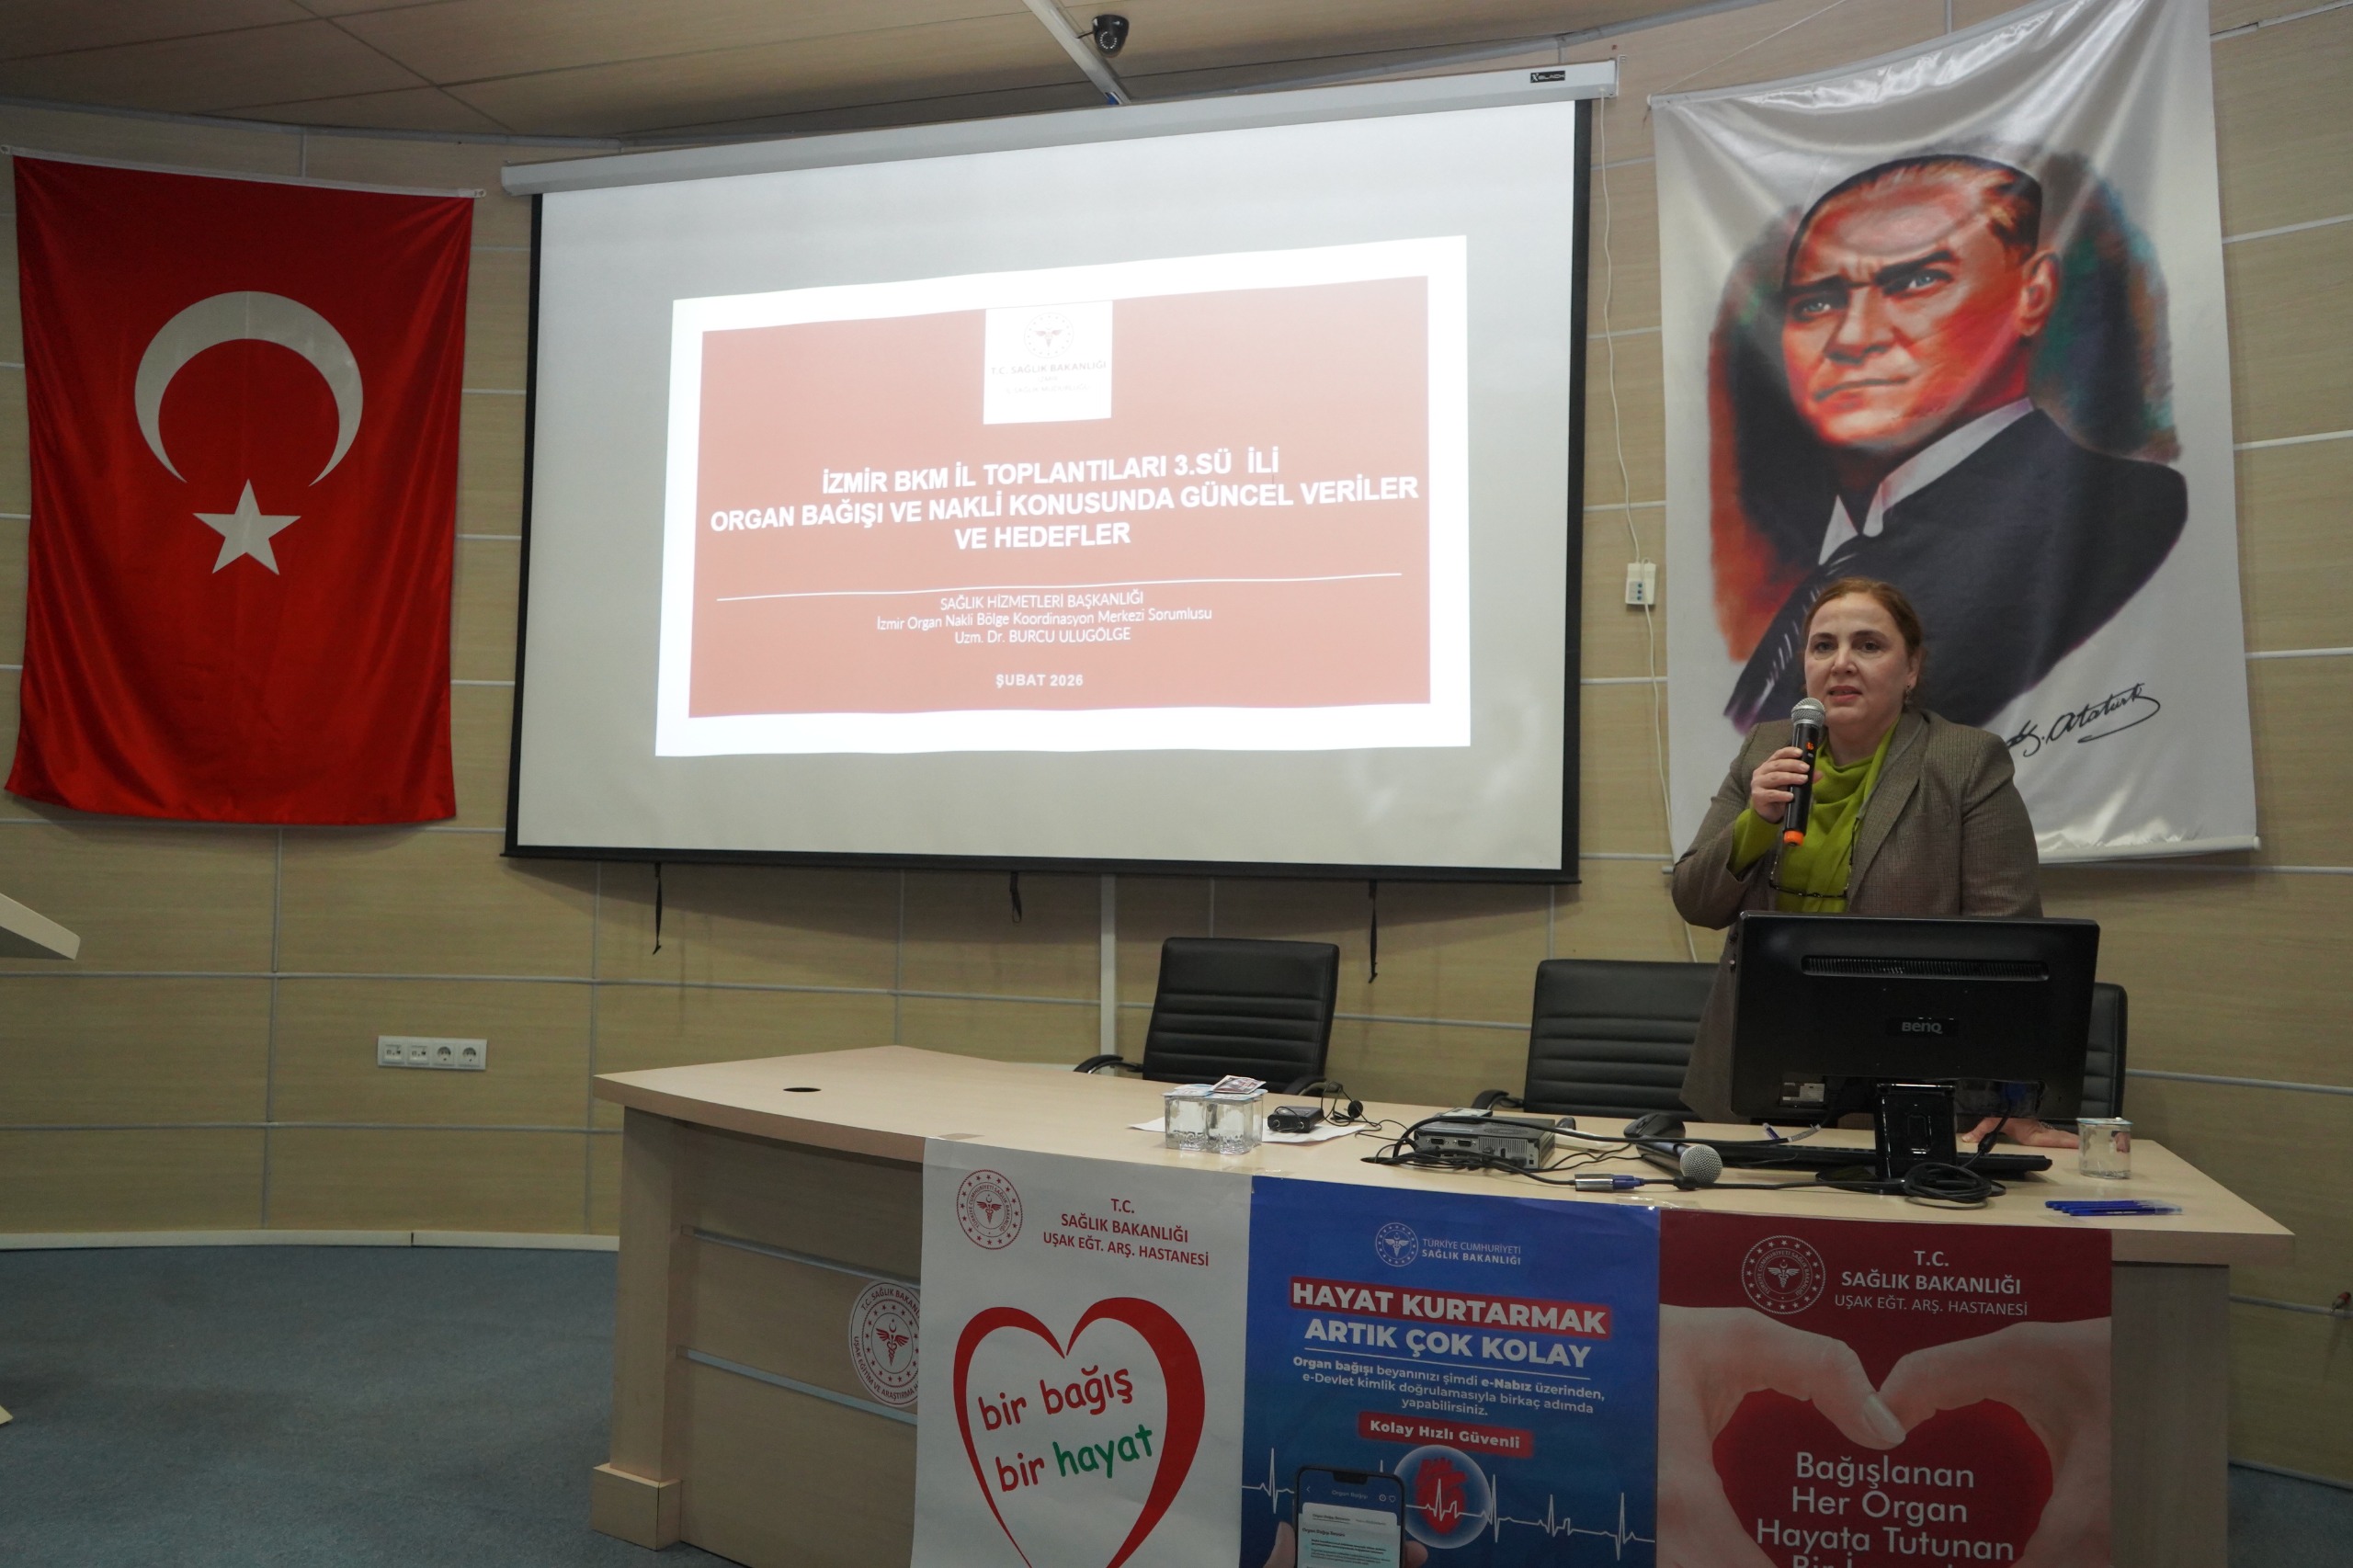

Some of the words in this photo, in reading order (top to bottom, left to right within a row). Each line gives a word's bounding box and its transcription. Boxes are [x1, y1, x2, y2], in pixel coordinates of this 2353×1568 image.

[1011, 364, 1047, 374] SAĞLIK
[1051, 360, 1107, 372] BAKANLIĞI
[823, 467, 888, 494] İZMİR
[894, 467, 949, 492] BKM
[955, 461, 976, 487] İL
[983, 455, 1166, 485] TOPLANTILARI
[1174, 448, 1232, 475] 3.SÜ
[1247, 446, 1279, 473] İLİ
[710, 506, 794, 531] ORGAN
[801, 498, 883, 528] BAĞIŞI
[890, 501, 922, 523] VE
[929, 491, 1002, 520] NAKLİ
[1009, 487, 1175, 516] KONUSUNDA
[1180, 481, 1293, 507] GÜNCEL
[1300, 473, 1419, 505] VERİLER
[954, 528, 987, 550] VE
[995, 522, 1131, 548] HEDEFLER
[940, 595, 983, 610] SAĞLIK
[987, 594, 1063, 608] HİZMETLERİ
[1067, 588, 1143, 609] BAŞKANLIĞI
[877, 616, 904, 631] İzmir
[907, 617, 942, 631] Organ
[945, 613, 973, 627] Nakli
[977, 612, 1009, 628] Bölge
[1013, 611, 1094, 627] Koordinasyon
[1097, 608, 1144, 623] Merkezi
[1148, 607, 1212, 621] Sorumlusu
[955, 631, 983, 643] Uzm.
[987, 631, 1006, 643] Dr.
[1009, 630, 1055, 642] BURCU
[1059, 627, 1131, 642] ULUGÖLGE
[995, 674, 1046, 688] ŞUBAT
[1050, 674, 1084, 687] 2026
[1110, 1198, 1135, 1214] T.C.
[1061, 1212, 1108, 1233] SAĞLIK
[1112, 1220, 1188, 1243] BAKANLIĞI
[1043, 1232, 1075, 1247] UŞAK
[1078, 1235, 1104, 1252] EĞT.
[1108, 1241, 1135, 1258] ARŞ.
[1139, 1245, 1209, 1267] HASTANESİ
[1422, 1238, 1458, 1250] TÜRKİYE
[1461, 1242, 1521, 1255] CUMHURİYETİ
[1422, 1249, 1459, 1261] SAĞLIK
[1462, 1254, 1521, 1265] BAKANLIĞI
[1914, 1250, 1949, 1267] T.C.
[871, 1287, 894, 1301] SAĞLIK
[1841, 1268, 1910, 1290] SAĞLIK
[1915, 1274, 2021, 1295] BAKANLIĞI
[1293, 1282, 1393, 1313] HAYAT
[1403, 1293, 1606, 1335] KURTARMAK
[1835, 1294, 1873, 1310] UŞAK
[1877, 1295, 1907, 1310] EĞT.
[1912, 1298, 1944, 1313] ARŞ.
[1949, 1300, 2028, 1316] HASTANESİ
[1304, 1318, 1397, 1348] ARTIK
[1406, 1329, 1472, 1358] ÇOK
[1483, 1336, 1591, 1368] KOLAY
[853, 1336, 861, 1357] UŞAK
[873, 1383, 881, 1392] VE
[881, 1388, 915, 1402] ARAŞTIRMA
[1293, 1357, 1332, 1369] Organ
[1336, 1360, 1373, 1376] bağışı
[1377, 1366, 1439, 1381] beyanınızı
[1442, 1372, 1478, 1385] şimdi
[1481, 1379, 1532, 1392] e-Nabız
[1535, 1382, 1605, 1402] üzerinden,
[978, 1392, 1028, 1431] bir
[1040, 1365, 1133, 1415] bağış
[1302, 1373, 1354, 1387] e-Devlet
[1358, 1377, 1396, 1392] kimlik
[1399, 1382, 1496, 1403] doğrulamasıyla
[1500, 1393, 1540, 1409] birkaç
[1544, 1399, 1594, 1414] adımda
[1402, 1398, 1488, 1415] yapabilirsiniz.
[1370, 1420, 1414, 1437] Kolay
[1419, 1426, 1454, 1440] Hızlı
[1459, 1430, 1520, 1449] Güvenli
[995, 1452, 1045, 1493] bir
[1052, 1424, 1153, 1479] hayat
[1796, 1451, 1974, 1489] Bağışlanan
[1792, 1486, 1850, 1516] Her
[1862, 1490, 1968, 1528] Organ
[1756, 1518, 1870, 1554] Hayata
[1882, 1526, 2014, 1561] Tutunan
